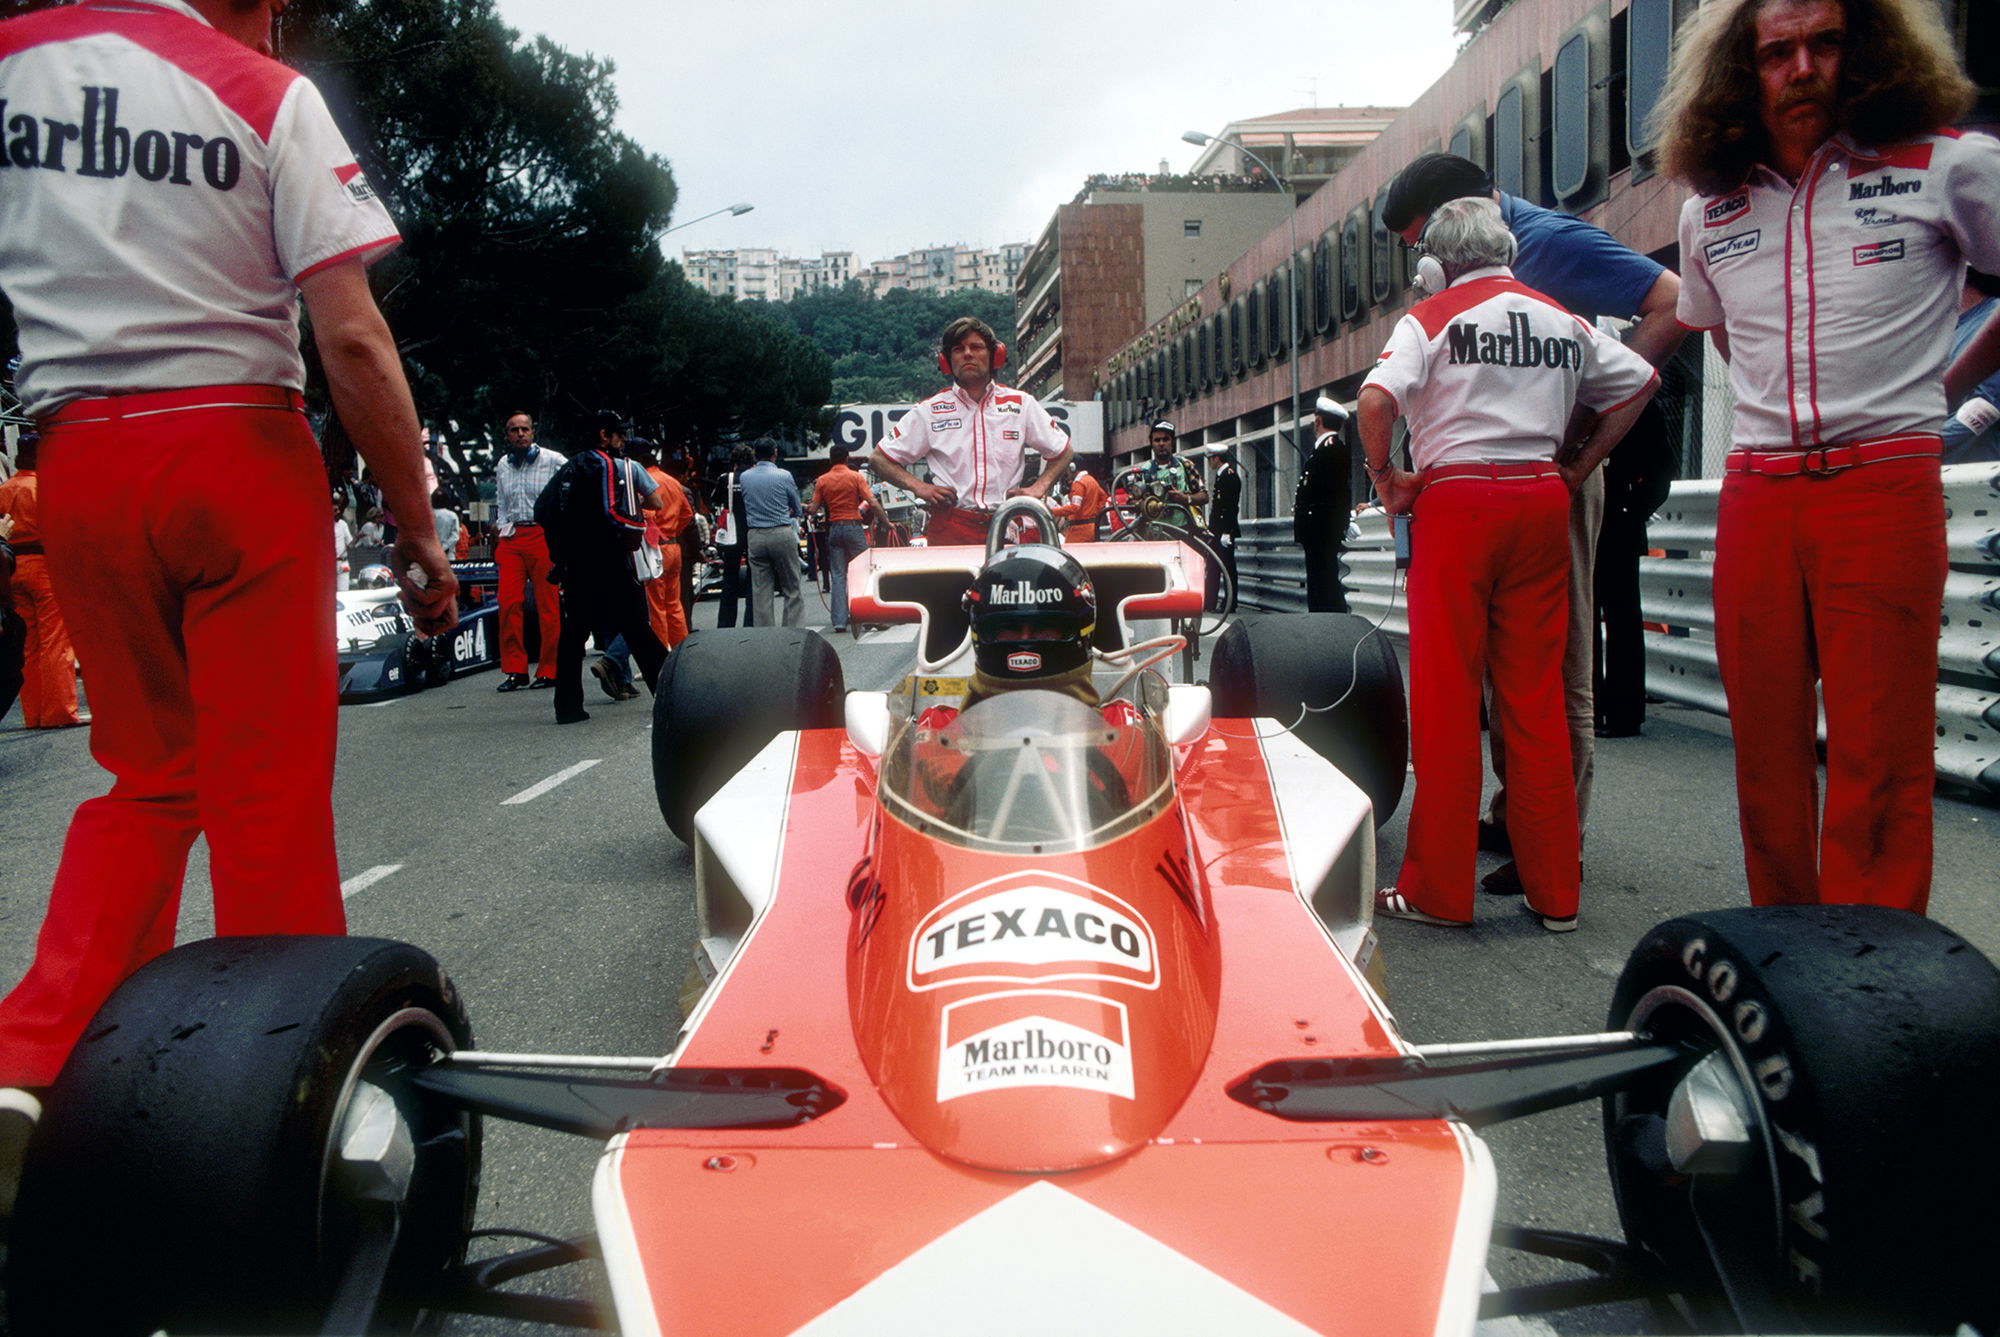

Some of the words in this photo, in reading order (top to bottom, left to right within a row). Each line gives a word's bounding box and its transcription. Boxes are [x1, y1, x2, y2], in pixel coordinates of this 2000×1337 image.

[1848, 176, 1922, 201] Marlboro
[1707, 195, 1746, 220] TEXACO
[1449, 311, 1583, 372] Marlboro
[989, 581, 1063, 605] Marlboro
[454, 629, 474, 661] elf
[474, 618, 487, 661] 4
[388, 668, 399, 681] elf
[1011, 658, 1037, 666] TEXACO
[926, 907, 1141, 960] TEXACO
[963, 1029, 1112, 1067] Marlboro
[964, 1065, 1016, 1083] TEAM
